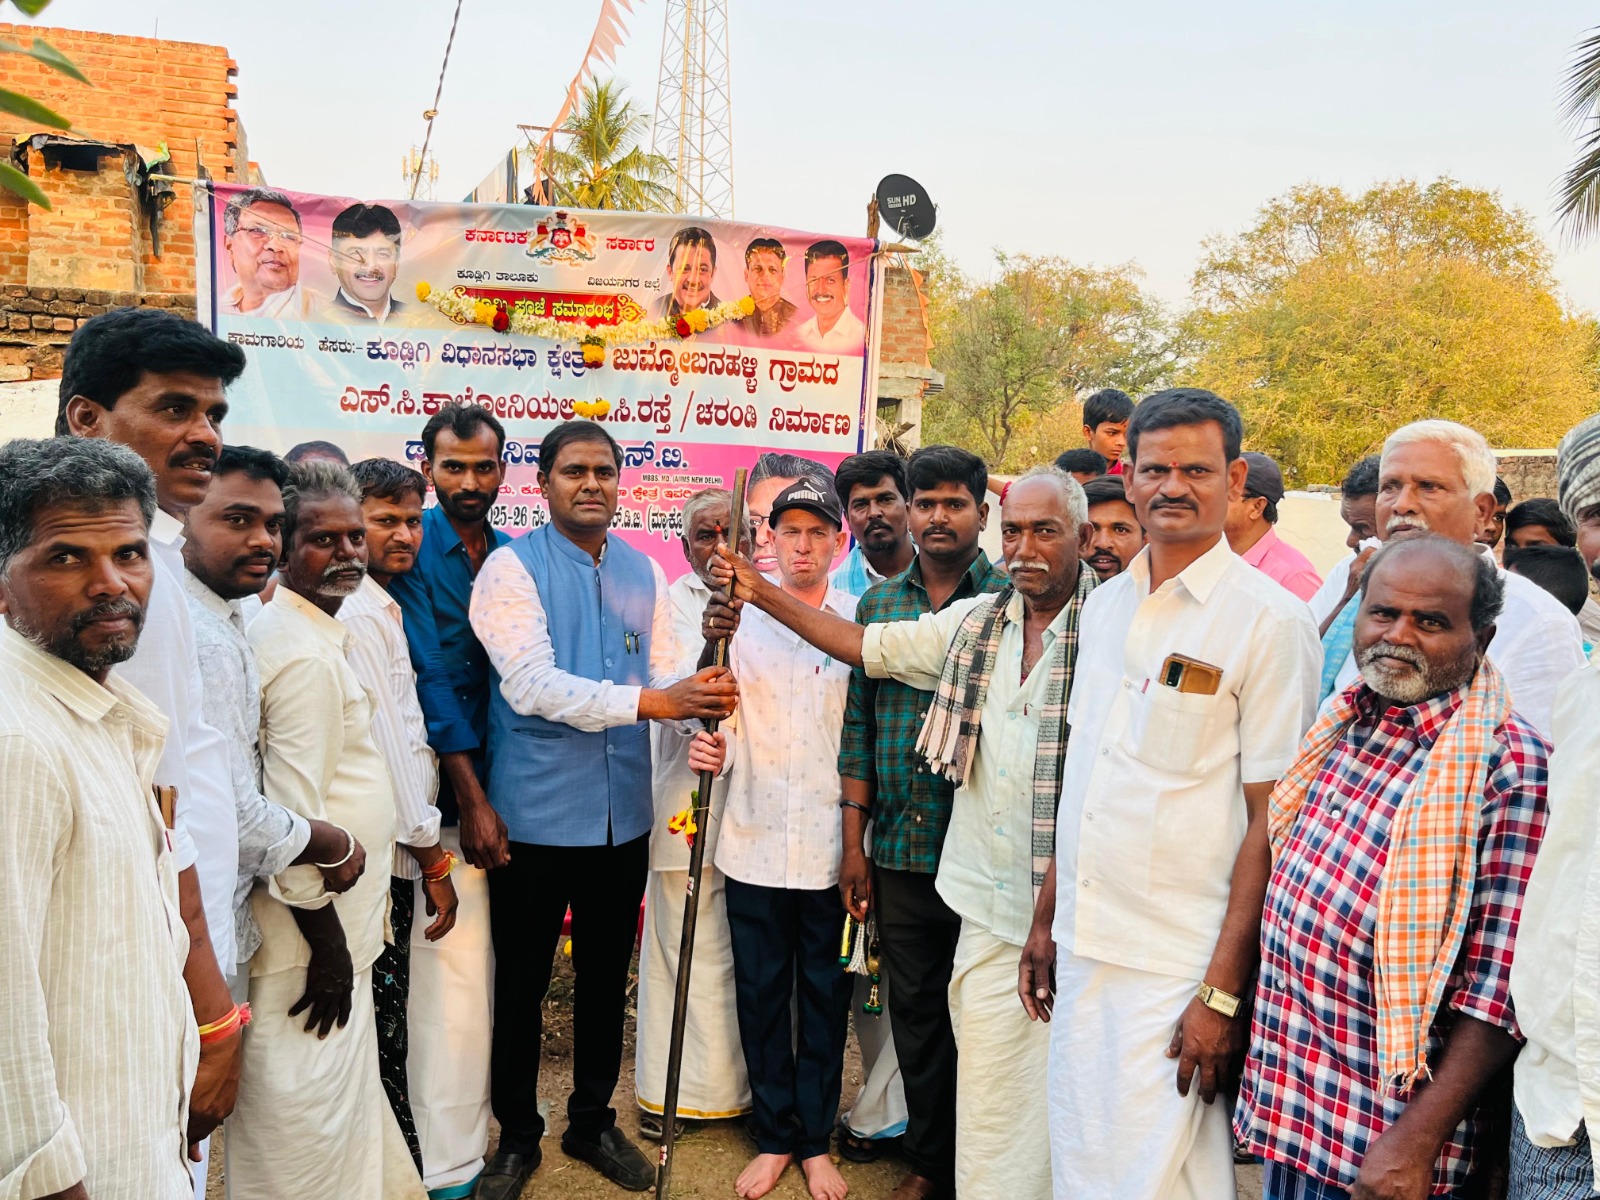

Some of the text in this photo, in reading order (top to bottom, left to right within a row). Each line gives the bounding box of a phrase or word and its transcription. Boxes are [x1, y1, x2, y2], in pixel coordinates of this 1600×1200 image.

[902, 194, 917, 206] HD
[465, 228, 529, 245] ಕರ್ನಾಟಕ
[606, 236, 655, 252] ಸರ್ಕಾರ
[456, 269, 539, 284] ಕೂಡ್ಲಿಗಿ ತಾಲೂಕು
[587, 276, 661, 292] ವಿಜಯನಗರ ಜಿಲ್ಲೆ
[551, 299, 615, 321] ಸಮಾರಂಭ
[227, 331, 305, 350] ಕಾಮಗಾರಿಯ
[366, 335, 431, 370] ಕೂಡ್ಲಿಗಿ
[441, 339, 537, 371] ವಿಧಾನಸಭಾ
[612, 341, 759, 394] ಜುಮ್ಮೋಬನಹಳ್ಳಿ
[768, 355, 840, 393] ಗ್ರಾಮದ
[769, 404, 850, 435] ನಿರ್ಮಾಣ
[691, 476, 704, 484] NEW
[632, 487, 658, 501] ಕ್ಷೇತ್ರ
[788, 490, 819, 502] PUMA
